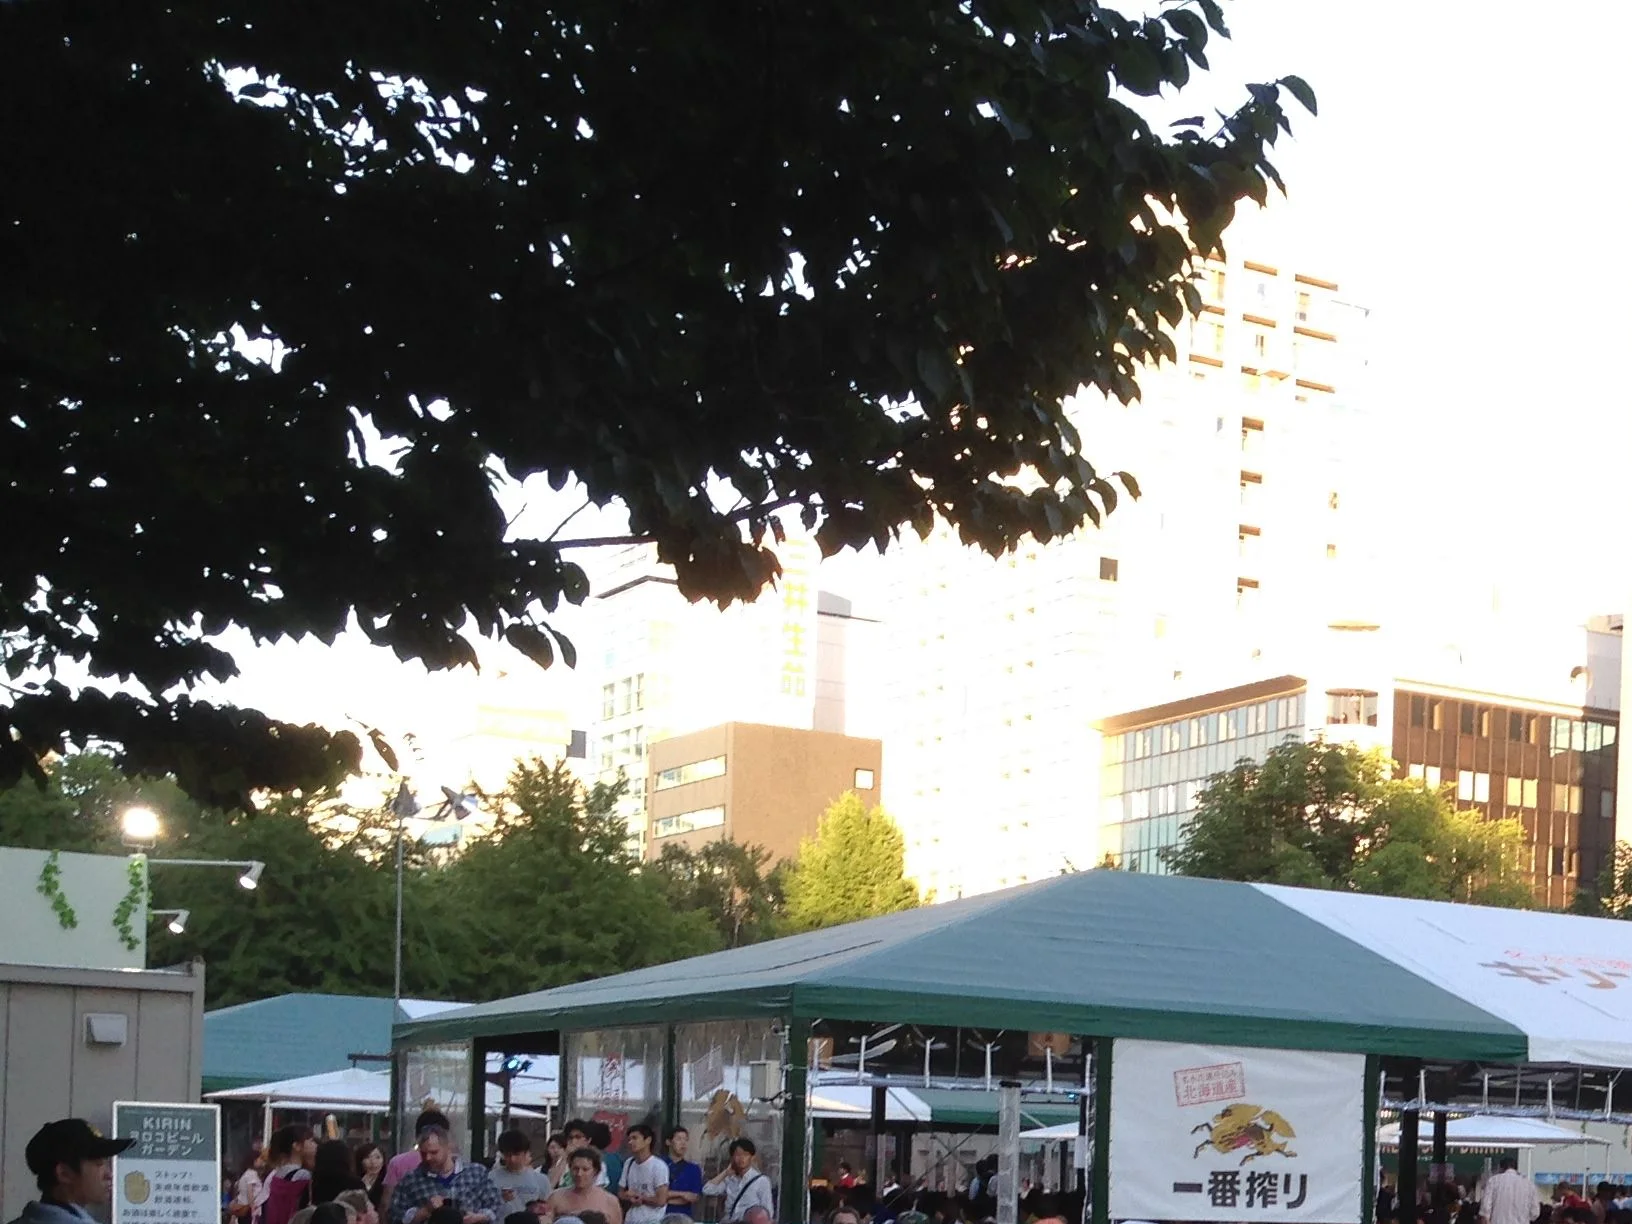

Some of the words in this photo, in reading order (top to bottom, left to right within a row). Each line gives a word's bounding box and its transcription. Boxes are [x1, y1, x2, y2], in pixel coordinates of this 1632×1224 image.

[143, 1116, 192, 1131] KIRIN
[1173, 1170, 1308, 1209] 一番搾り
